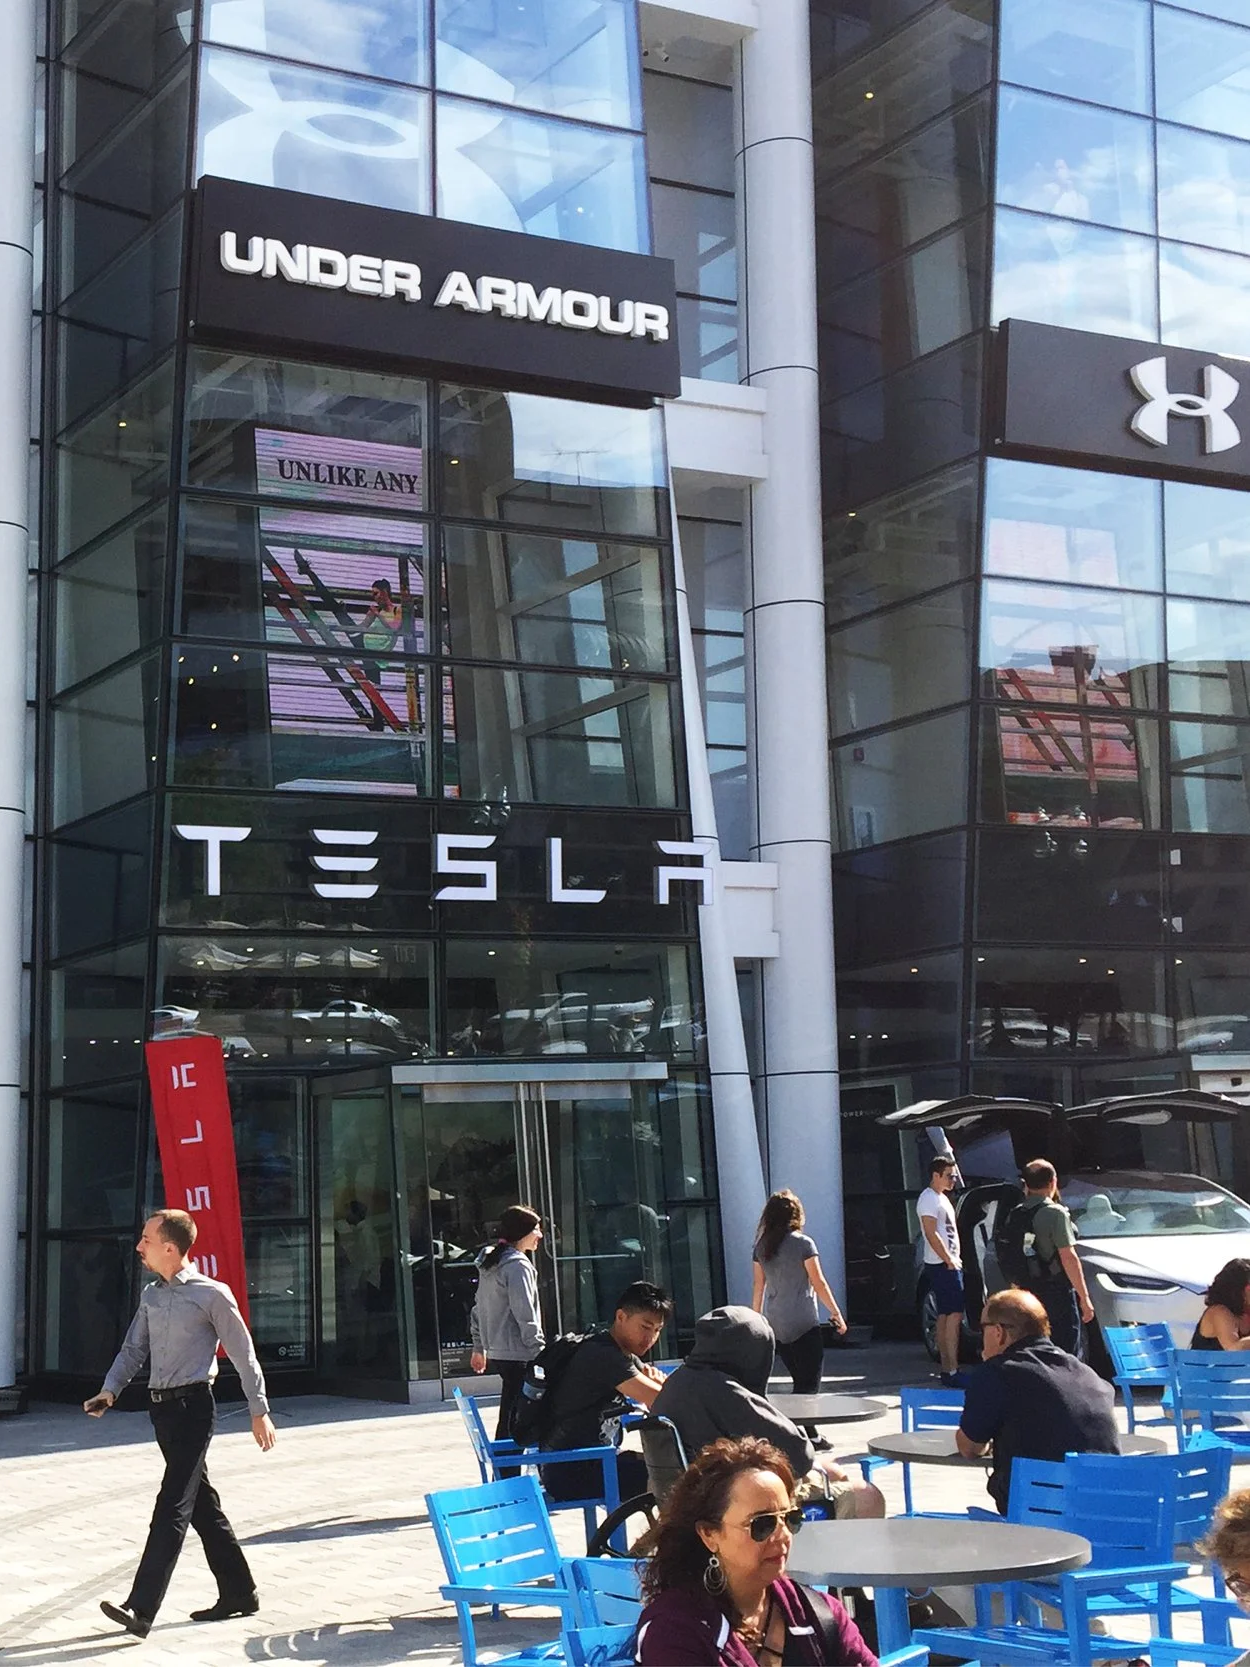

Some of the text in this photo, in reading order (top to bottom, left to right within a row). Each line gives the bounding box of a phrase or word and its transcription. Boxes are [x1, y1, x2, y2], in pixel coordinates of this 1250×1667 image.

[219, 231, 670, 343] UNDER ARMOUR
[277, 458, 419, 496] UNLIKE ANY
[172, 824, 713, 906] TESLA
[171, 1062, 218, 1278] ESLA
